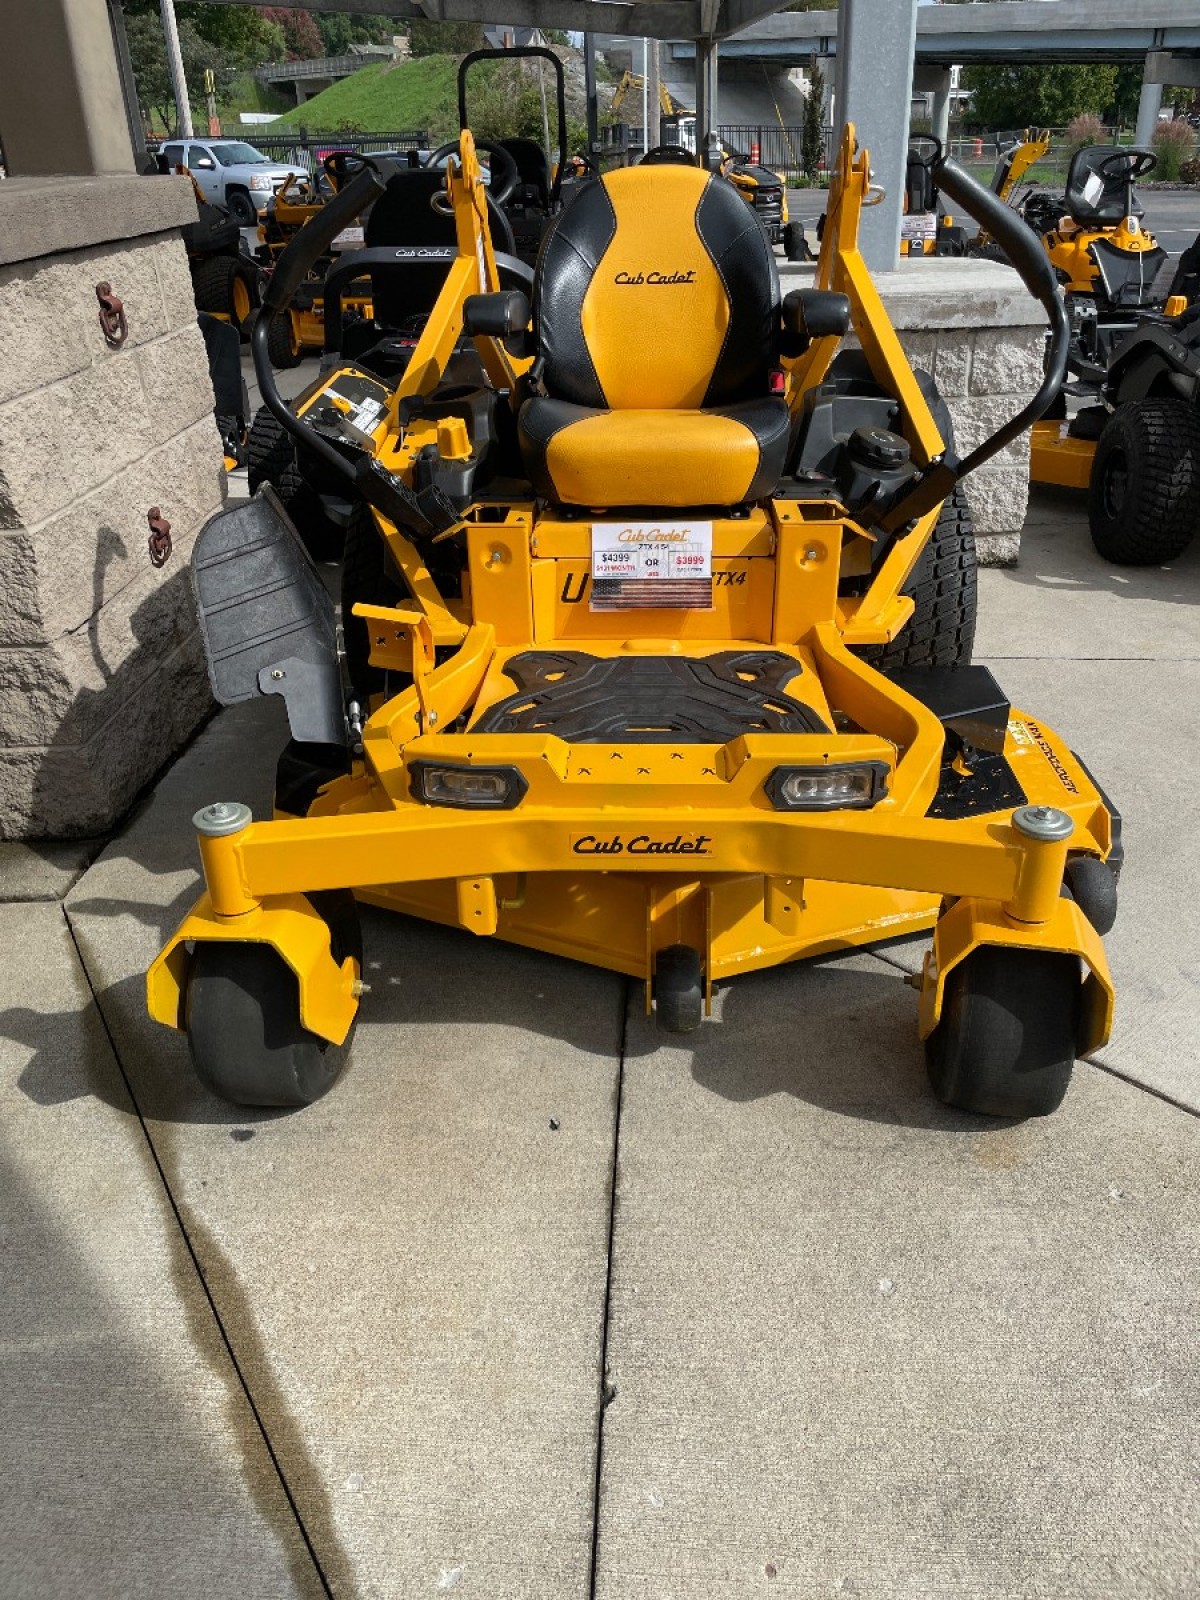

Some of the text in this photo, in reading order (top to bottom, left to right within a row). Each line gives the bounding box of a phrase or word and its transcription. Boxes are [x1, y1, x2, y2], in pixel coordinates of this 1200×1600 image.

[614, 270, 697, 285] Cub Cadet
[618, 528, 691, 542] Cub Cadet
[602, 552, 630, 563] $4399
[645, 558, 659, 567] OR
[573, 835, 712, 854] Cub Cadet
